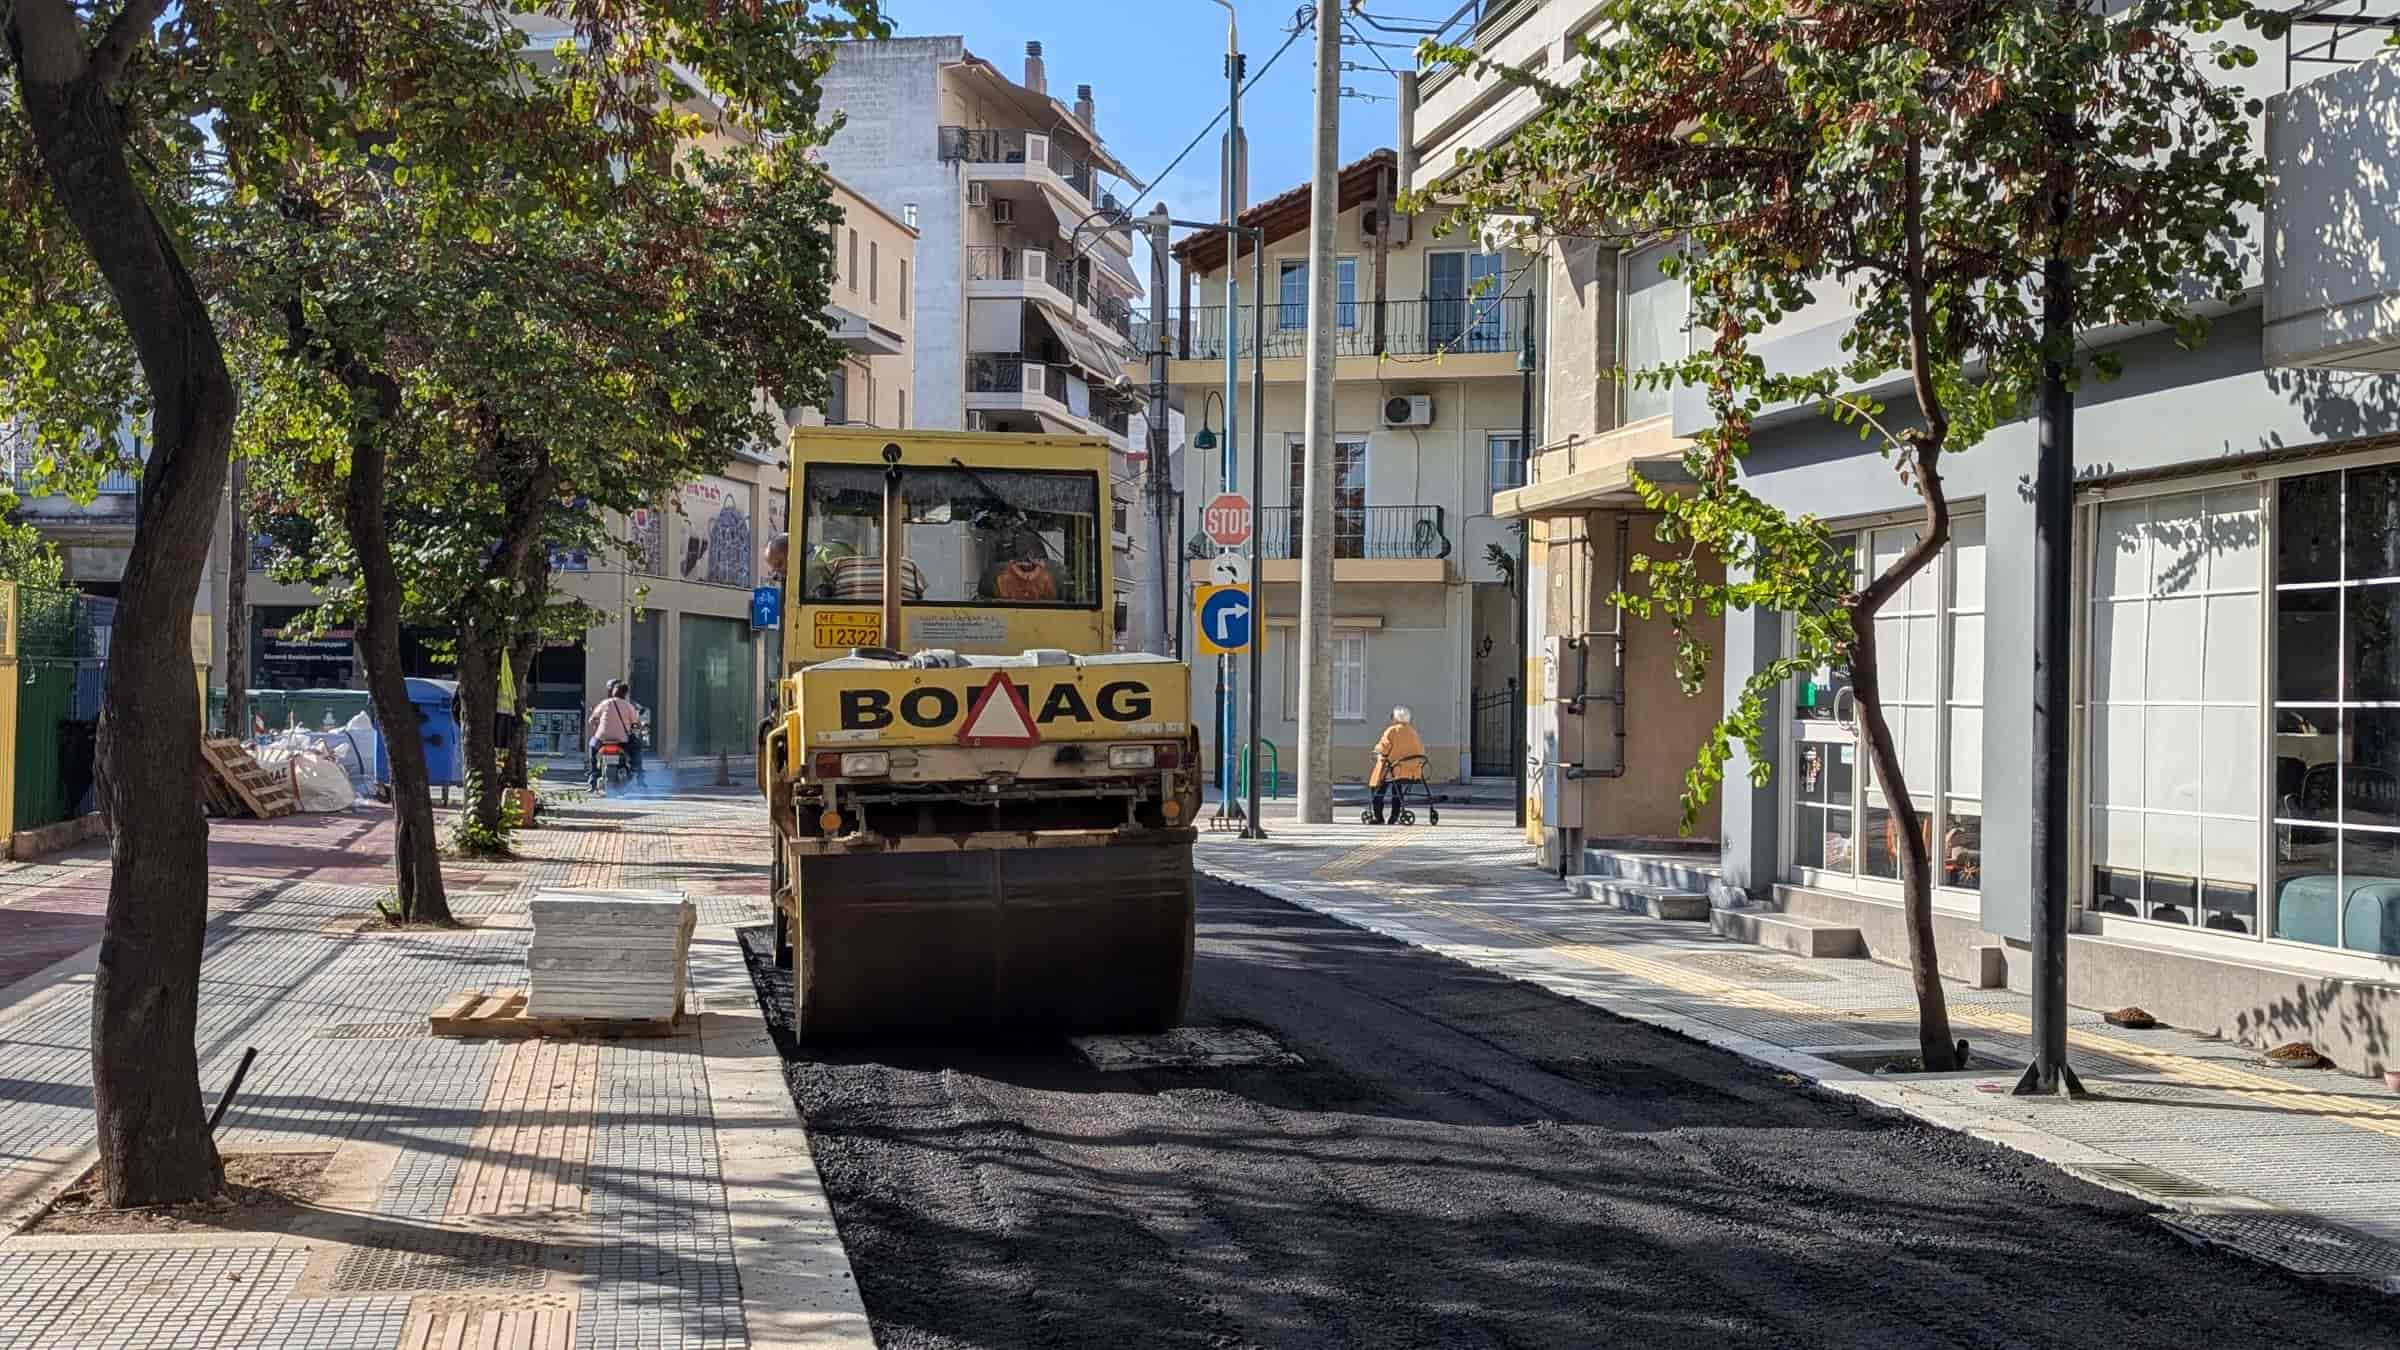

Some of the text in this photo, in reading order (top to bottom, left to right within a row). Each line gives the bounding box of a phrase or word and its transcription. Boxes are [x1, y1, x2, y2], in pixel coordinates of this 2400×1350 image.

[1208, 508, 1249, 534] STOP
[818, 629, 878, 646] 112322
[840, 681, 1152, 730] BOAG
